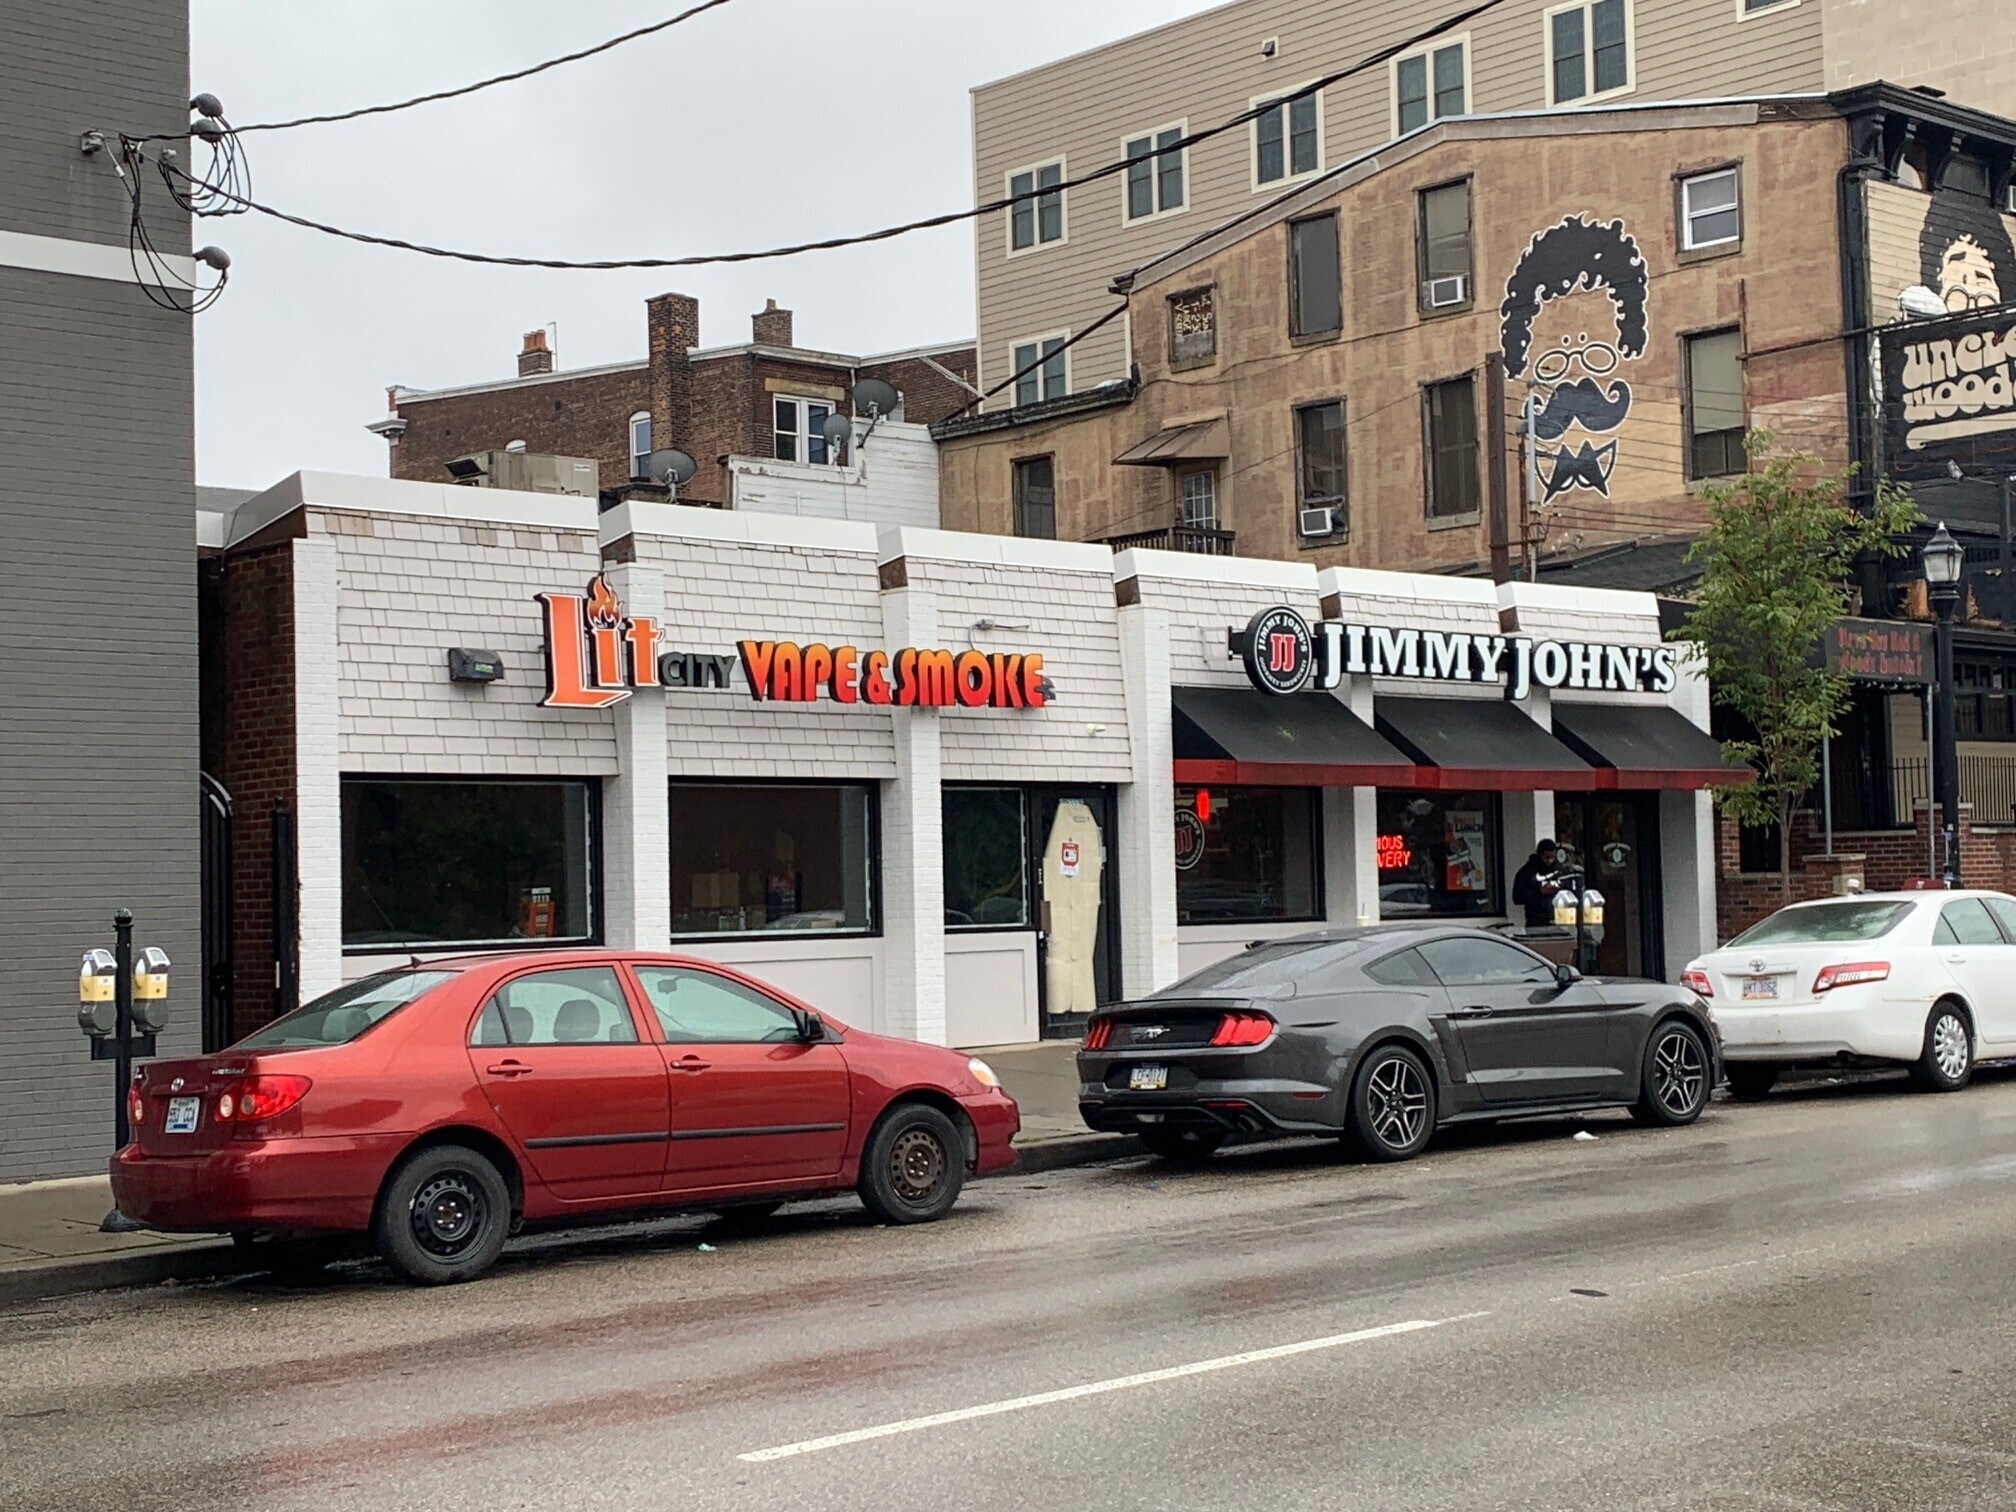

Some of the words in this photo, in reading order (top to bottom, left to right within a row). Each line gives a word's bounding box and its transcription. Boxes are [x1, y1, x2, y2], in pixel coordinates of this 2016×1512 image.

[1903, 363, 2016, 424] wood
[537, 578, 665, 708] Lit
[660, 652, 737, 688] CITY
[737, 640, 858, 702] VAPE
[891, 648, 1046, 708] SMOKE
[1258, 614, 1281, 651] JIMMY
[1270, 633, 1296, 672] JJ
[1318, 622, 1506, 690] JIMMY
[1513, 637, 1677, 700] JOHN'S
